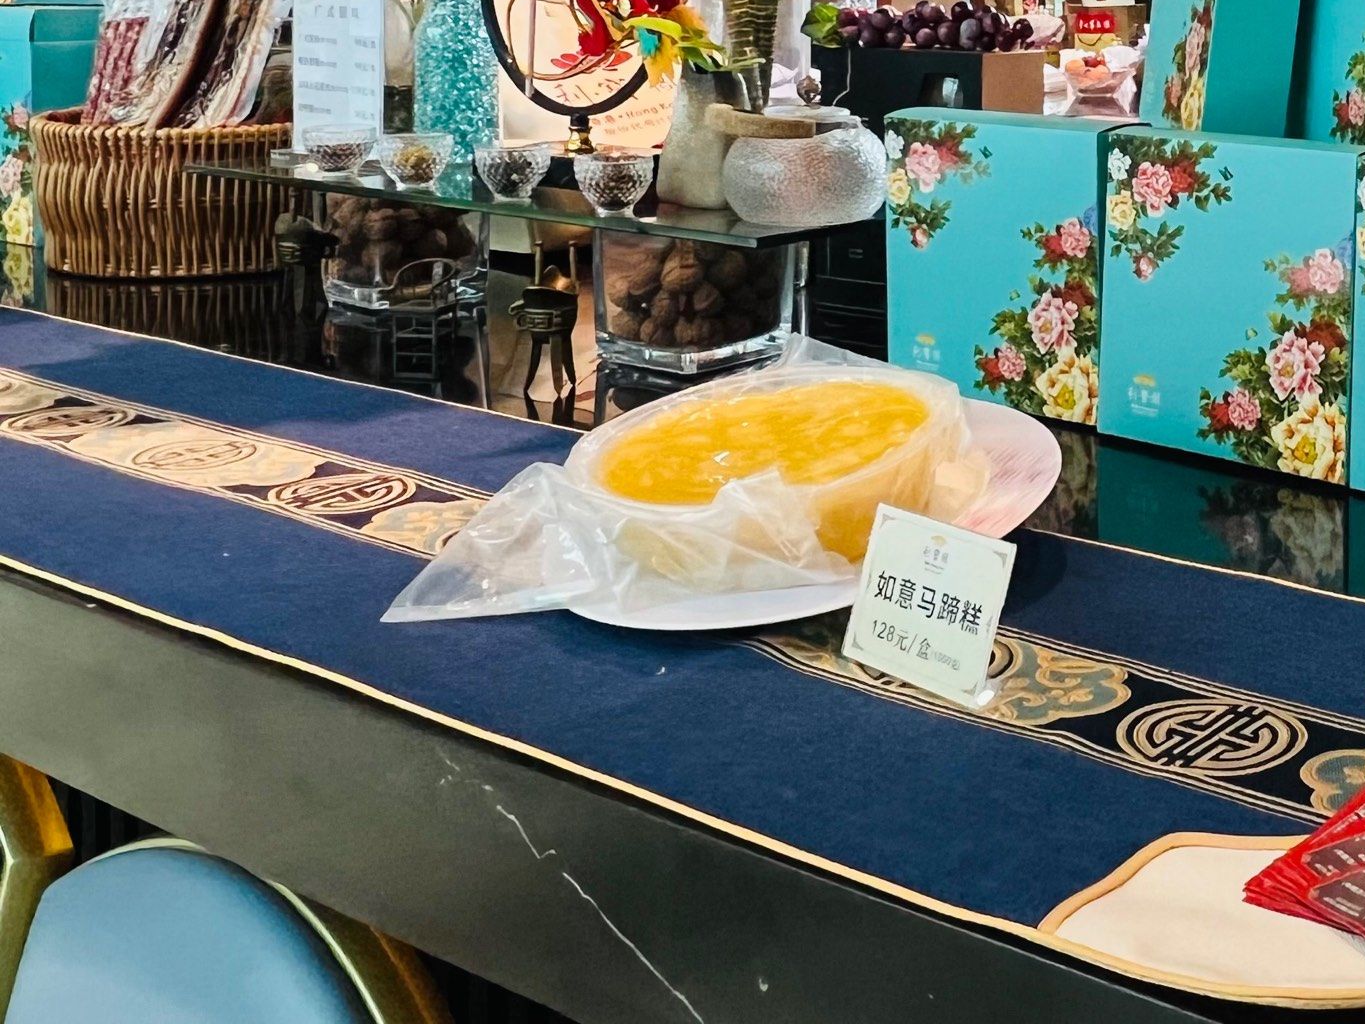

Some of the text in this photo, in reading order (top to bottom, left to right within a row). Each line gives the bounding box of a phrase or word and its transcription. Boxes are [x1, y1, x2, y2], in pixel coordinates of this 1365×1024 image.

[873, 570, 983, 636] 如意马蹄糕
